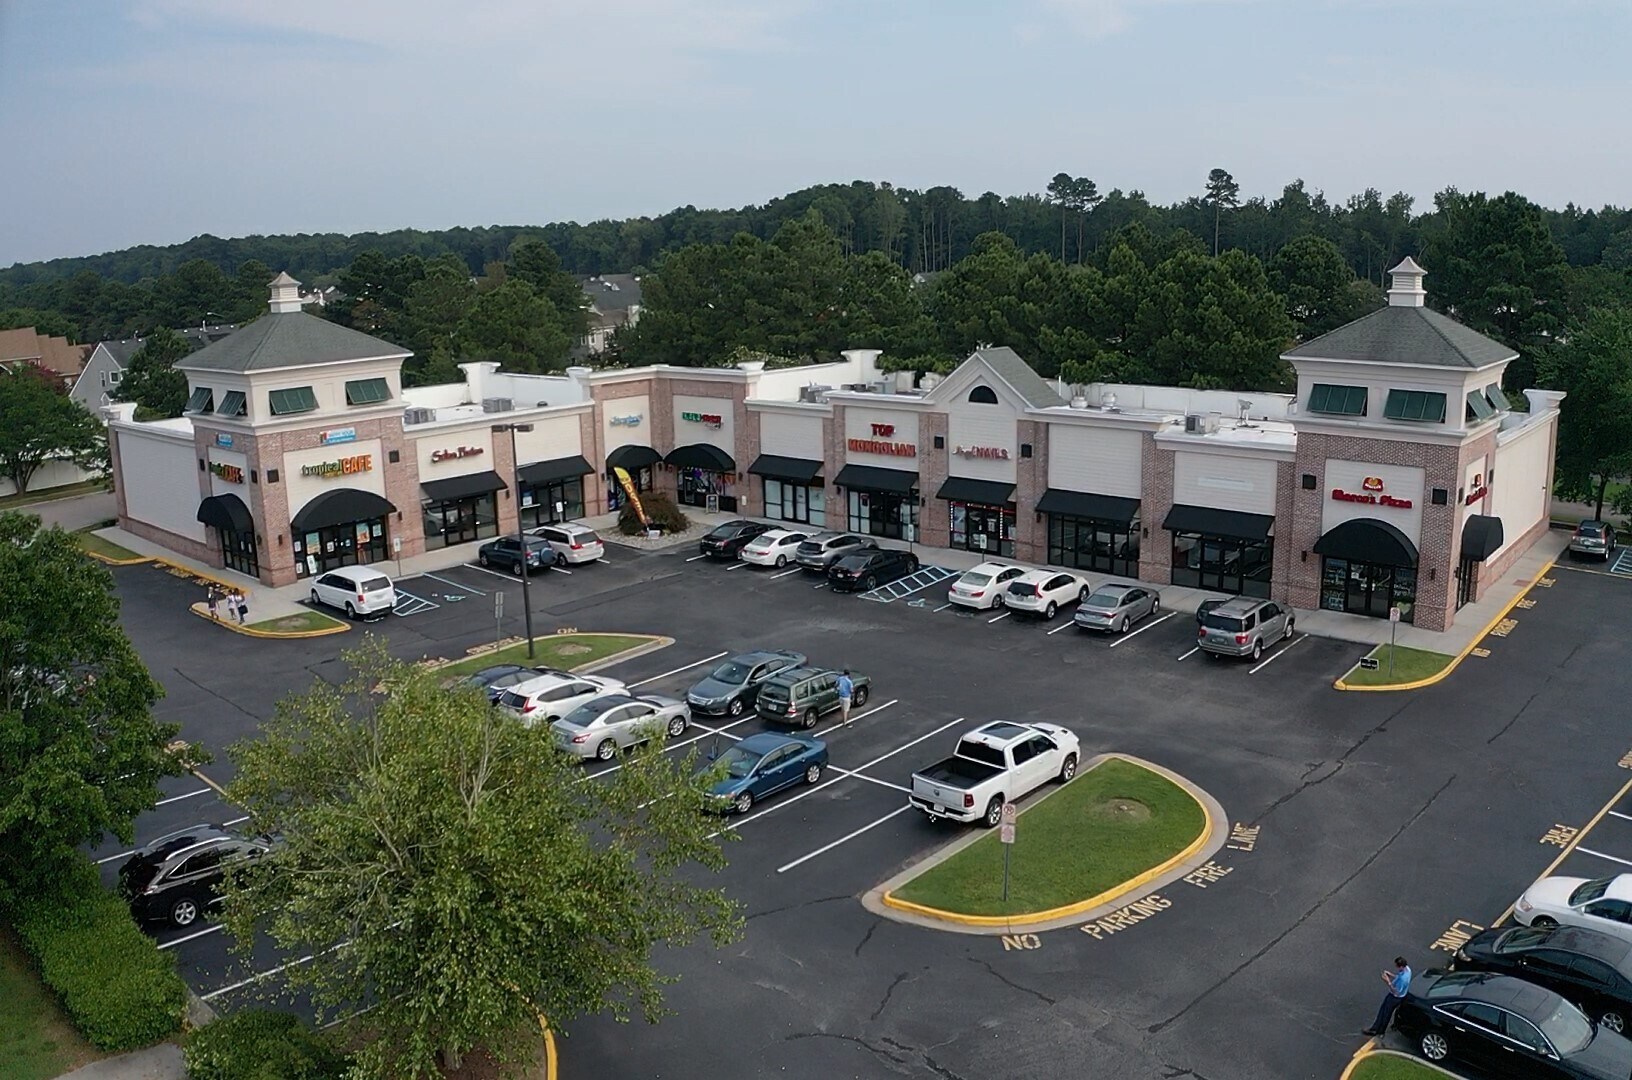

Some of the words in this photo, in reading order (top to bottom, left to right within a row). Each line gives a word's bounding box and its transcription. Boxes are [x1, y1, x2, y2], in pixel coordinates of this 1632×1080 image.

[870, 423, 895, 438] TOP
[848, 438, 917, 458] MONGOLIAN
[301, 459, 342, 477] tropical
[342, 454, 373, 474] CAFE
[1001, 933, 1043, 952] NO
[1080, 894, 1174, 941] PARKING
[1182, 860, 1235, 889] FIRE
[1226, 821, 1262, 852] LANE
